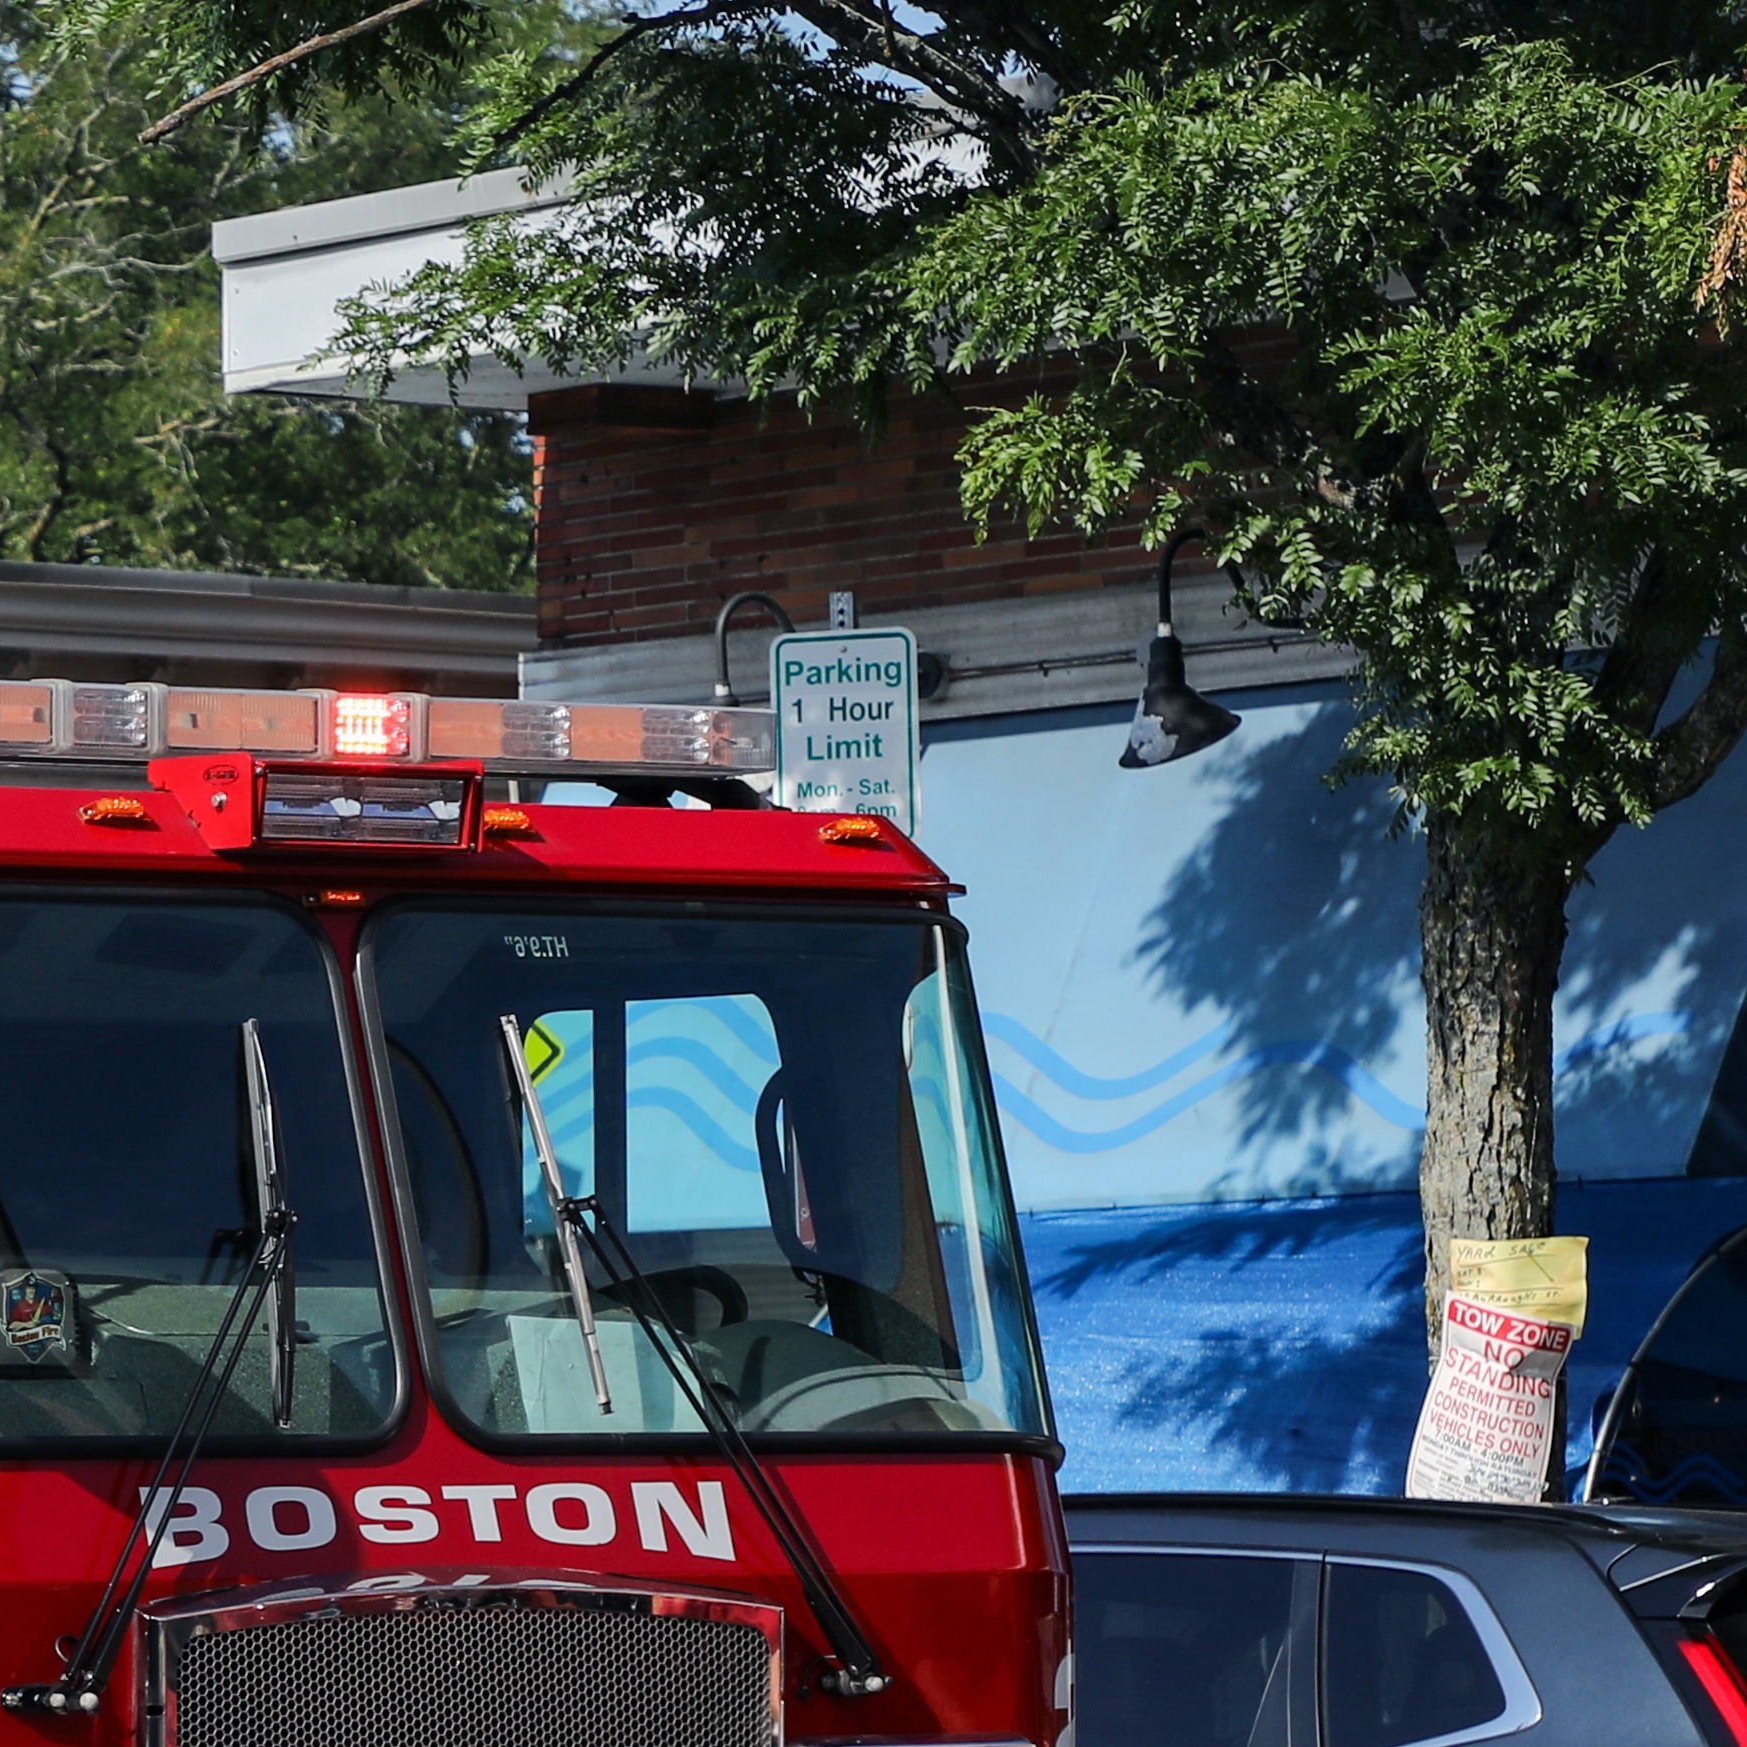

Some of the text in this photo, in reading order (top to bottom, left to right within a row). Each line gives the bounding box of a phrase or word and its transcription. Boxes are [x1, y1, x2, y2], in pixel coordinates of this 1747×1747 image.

[784, 657, 902, 688] Parking
[792, 696, 894, 723] 1 Hour
[807, 732, 883, 761] Limit
[797, 781, 844, 799] Mon.
[859, 779, 895, 796] Sat.
[1454, 1303, 1567, 1350] TOW ZONE
[1445, 1347, 1552, 1399] STANDING
[1483, 1340, 1526, 1370] NO
[1434, 1391, 1545, 1440] CONSTRUCTION
[1449, 1377, 1536, 1418] PERMITTED
[1430, 1410, 1542, 1459] VEHICLES ONLY
[1435, 1430, 1472, 1451] 7:00AM
[1480, 1448, 1524, 1467] 4:00PM
[140, 1480, 737, 1570] BOSTON
